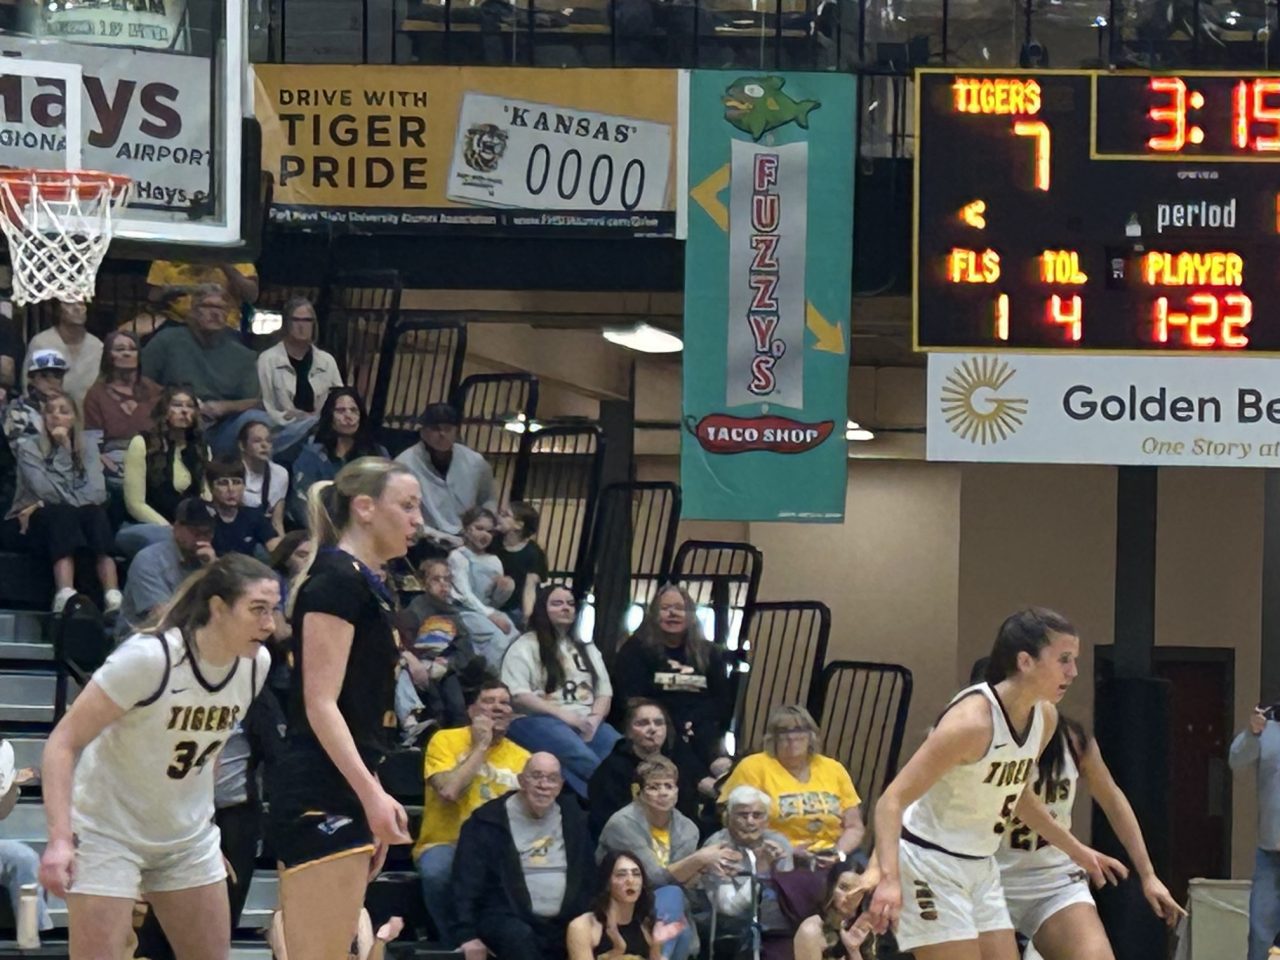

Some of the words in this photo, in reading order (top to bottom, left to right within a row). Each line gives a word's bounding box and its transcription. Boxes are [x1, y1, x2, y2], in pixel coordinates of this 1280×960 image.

[279, 89, 352, 107] DRIVE
[364, 90, 427, 107] WITH
[953, 78, 1041, 115] TIGERS
[279, 113, 426, 148] TIGER
[509, 106, 631, 143] KANSAS
[279, 155, 428, 190] PRIDE
[1013, 121, 1050, 191] 7
[526, 143, 645, 210] 0000
[1157, 198, 1237, 234] period
[747, 153, 786, 396] FUZZY'S
[951, 247, 1001, 284] FLS
[1042, 249, 1088, 285] TOL
[1144, 250, 1244, 287] PLAYER
[996, 293, 1009, 341] 1
[1048, 294, 1082, 341] 4
[1152, 294, 1252, 347] 1-22
[1062, 384, 1221, 423] Golden
[706, 425, 758, 443] TACO
[762, 427, 819, 444] SHOP
[1141, 437, 1185, 456] One
[1191, 438, 1251, 459] Story
[1259, 440, 1279, 458] at
